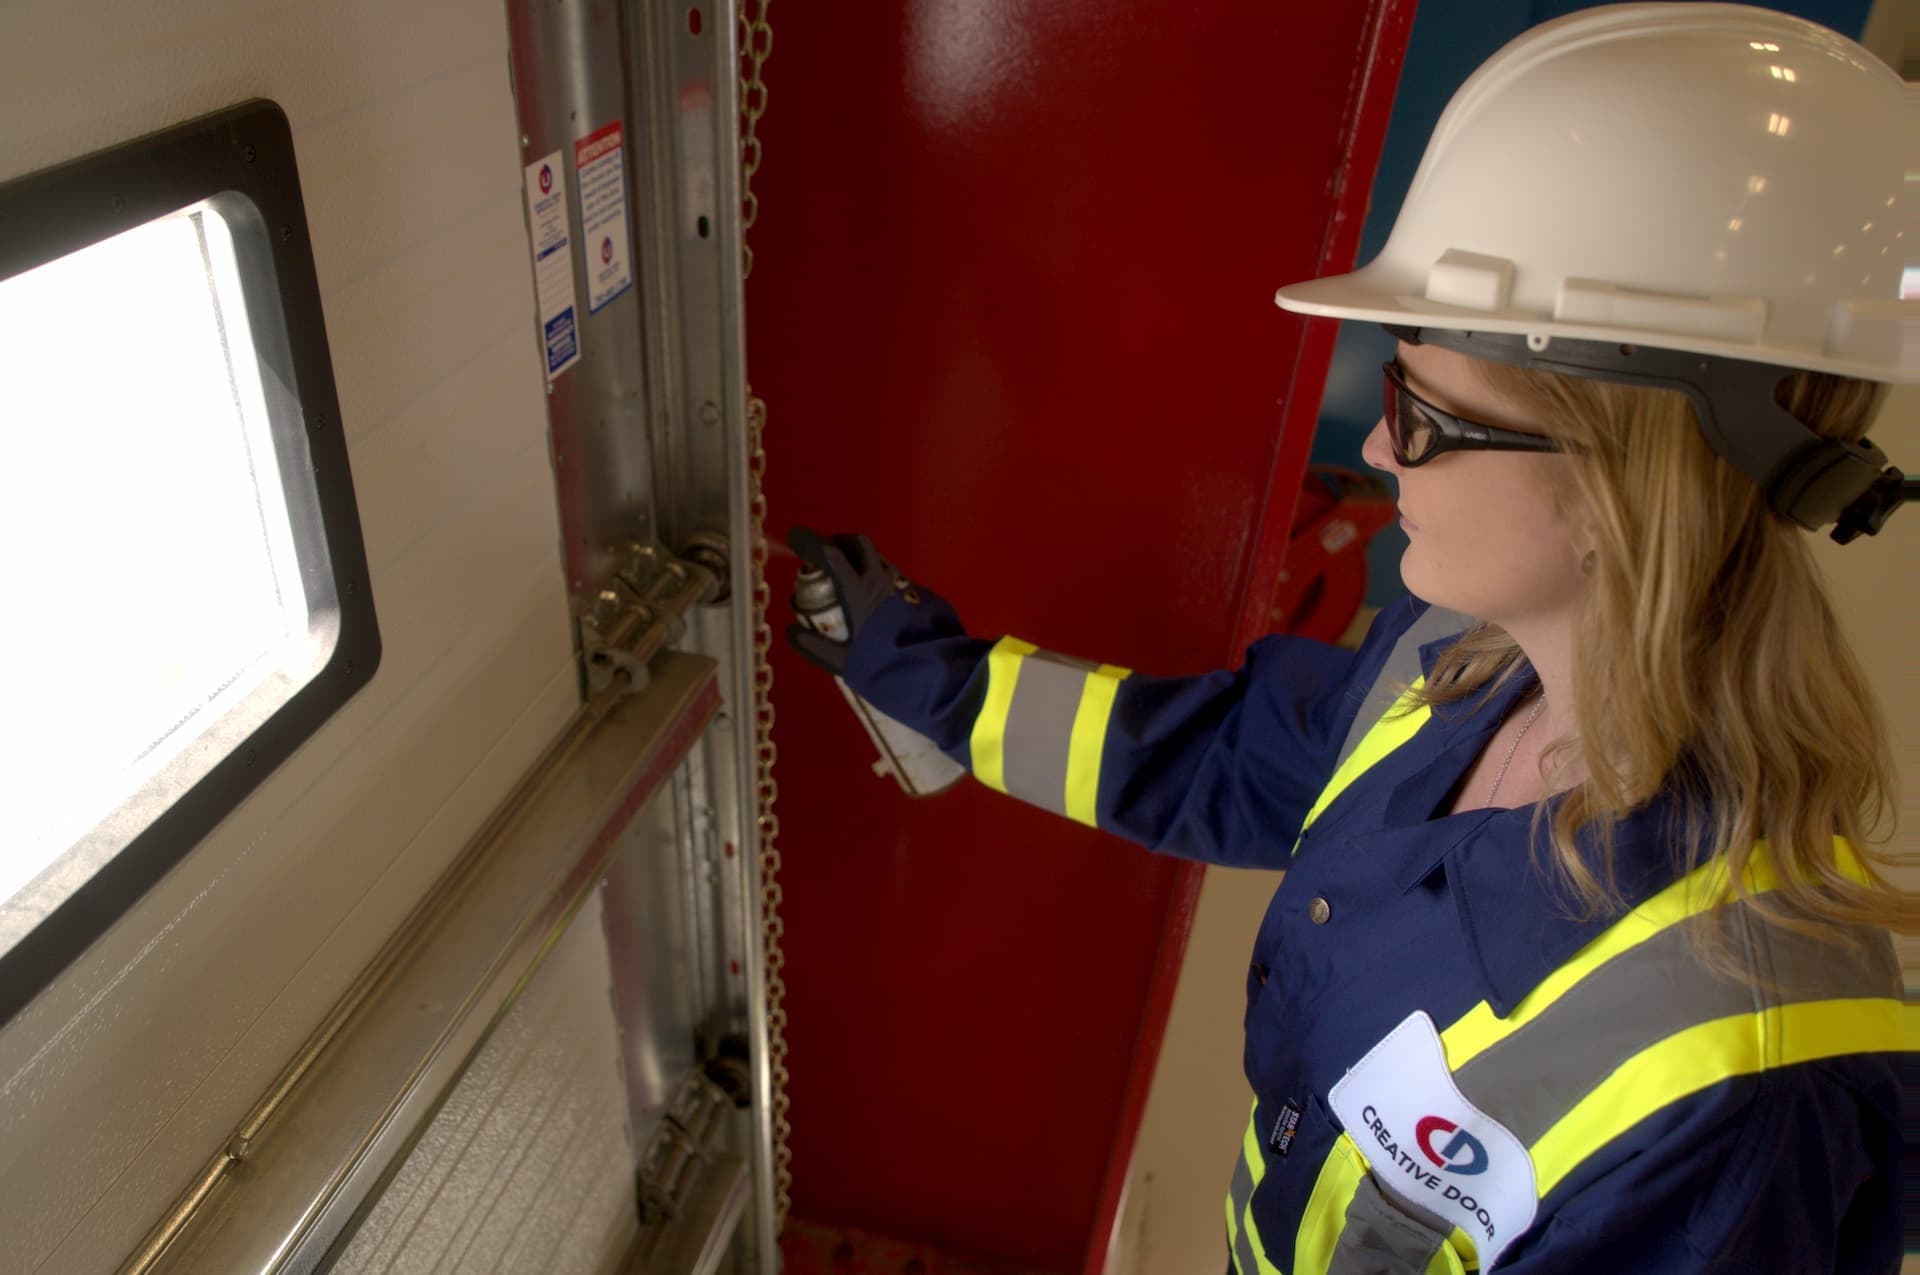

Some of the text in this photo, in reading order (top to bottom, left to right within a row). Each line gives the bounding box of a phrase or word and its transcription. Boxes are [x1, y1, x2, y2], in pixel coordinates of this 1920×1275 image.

[1362, 1105, 1442, 1190] CREATIVE
[1442, 1185, 1495, 1242] DOOR
[1416, 1115, 1489, 1175] CD
